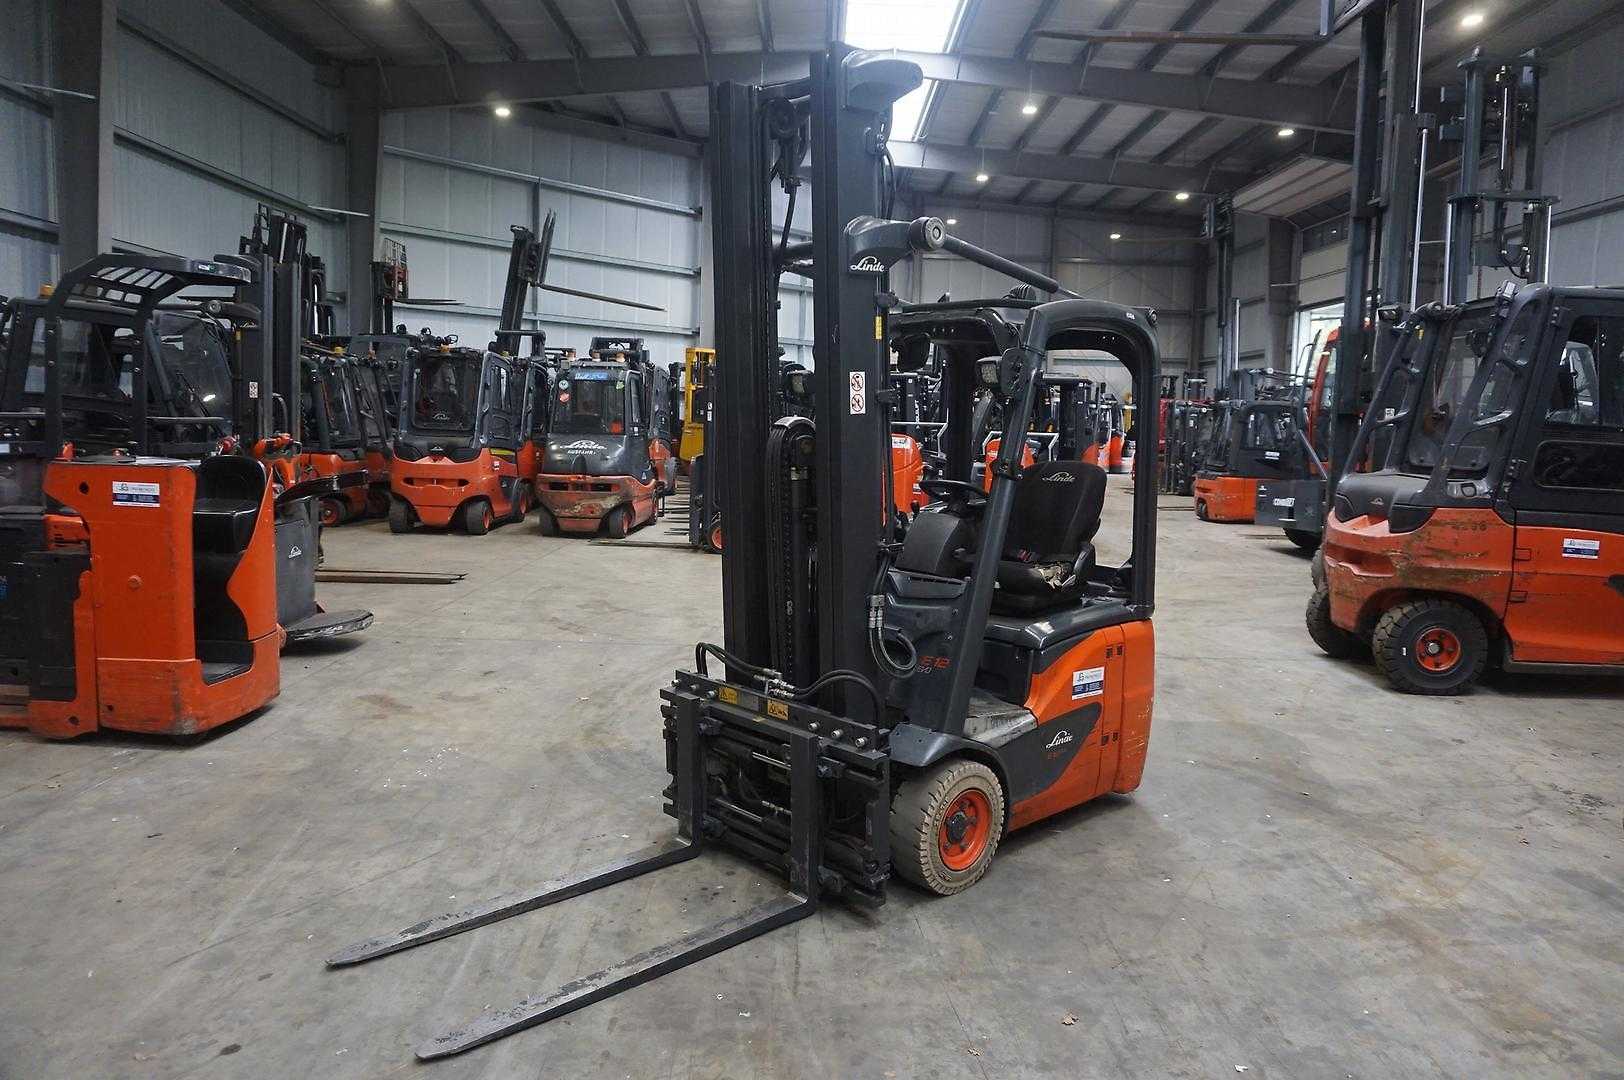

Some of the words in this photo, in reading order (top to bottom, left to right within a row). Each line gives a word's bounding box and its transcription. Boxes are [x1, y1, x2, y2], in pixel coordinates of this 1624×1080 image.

[850, 255, 885, 272] Linde
[1041, 471, 1076, 483] Linde
[1045, 730, 1073, 749] Linde
